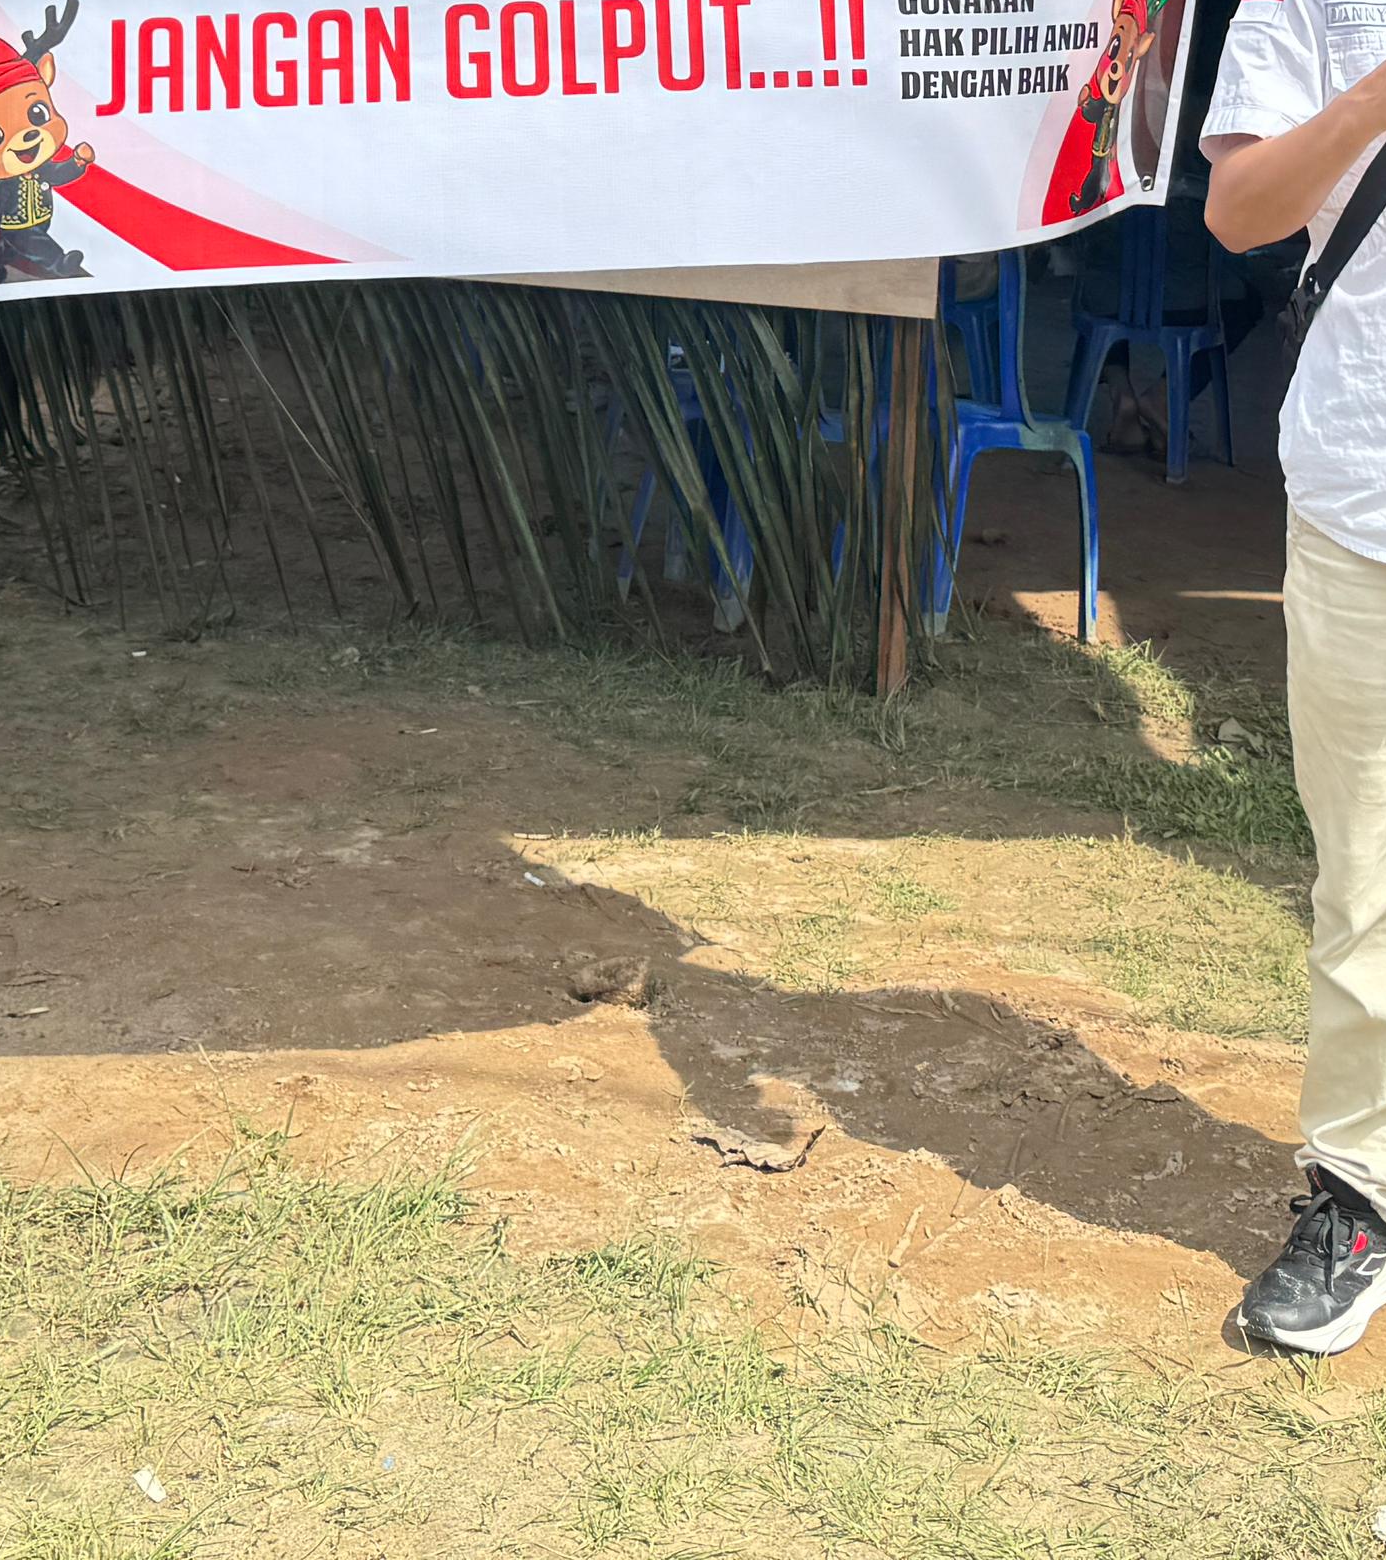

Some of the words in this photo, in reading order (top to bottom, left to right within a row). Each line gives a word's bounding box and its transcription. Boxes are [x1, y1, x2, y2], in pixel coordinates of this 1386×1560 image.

[899, 28, 966, 58] HAK
[971, 23, 1041, 55] PILIH
[1044, 21, 1100, 51] ANDA
[95, 6, 411, 116] JANGAN
[901, 67, 1012, 101] DENGAN
[1017, 63, 1070, 96] BAIK
